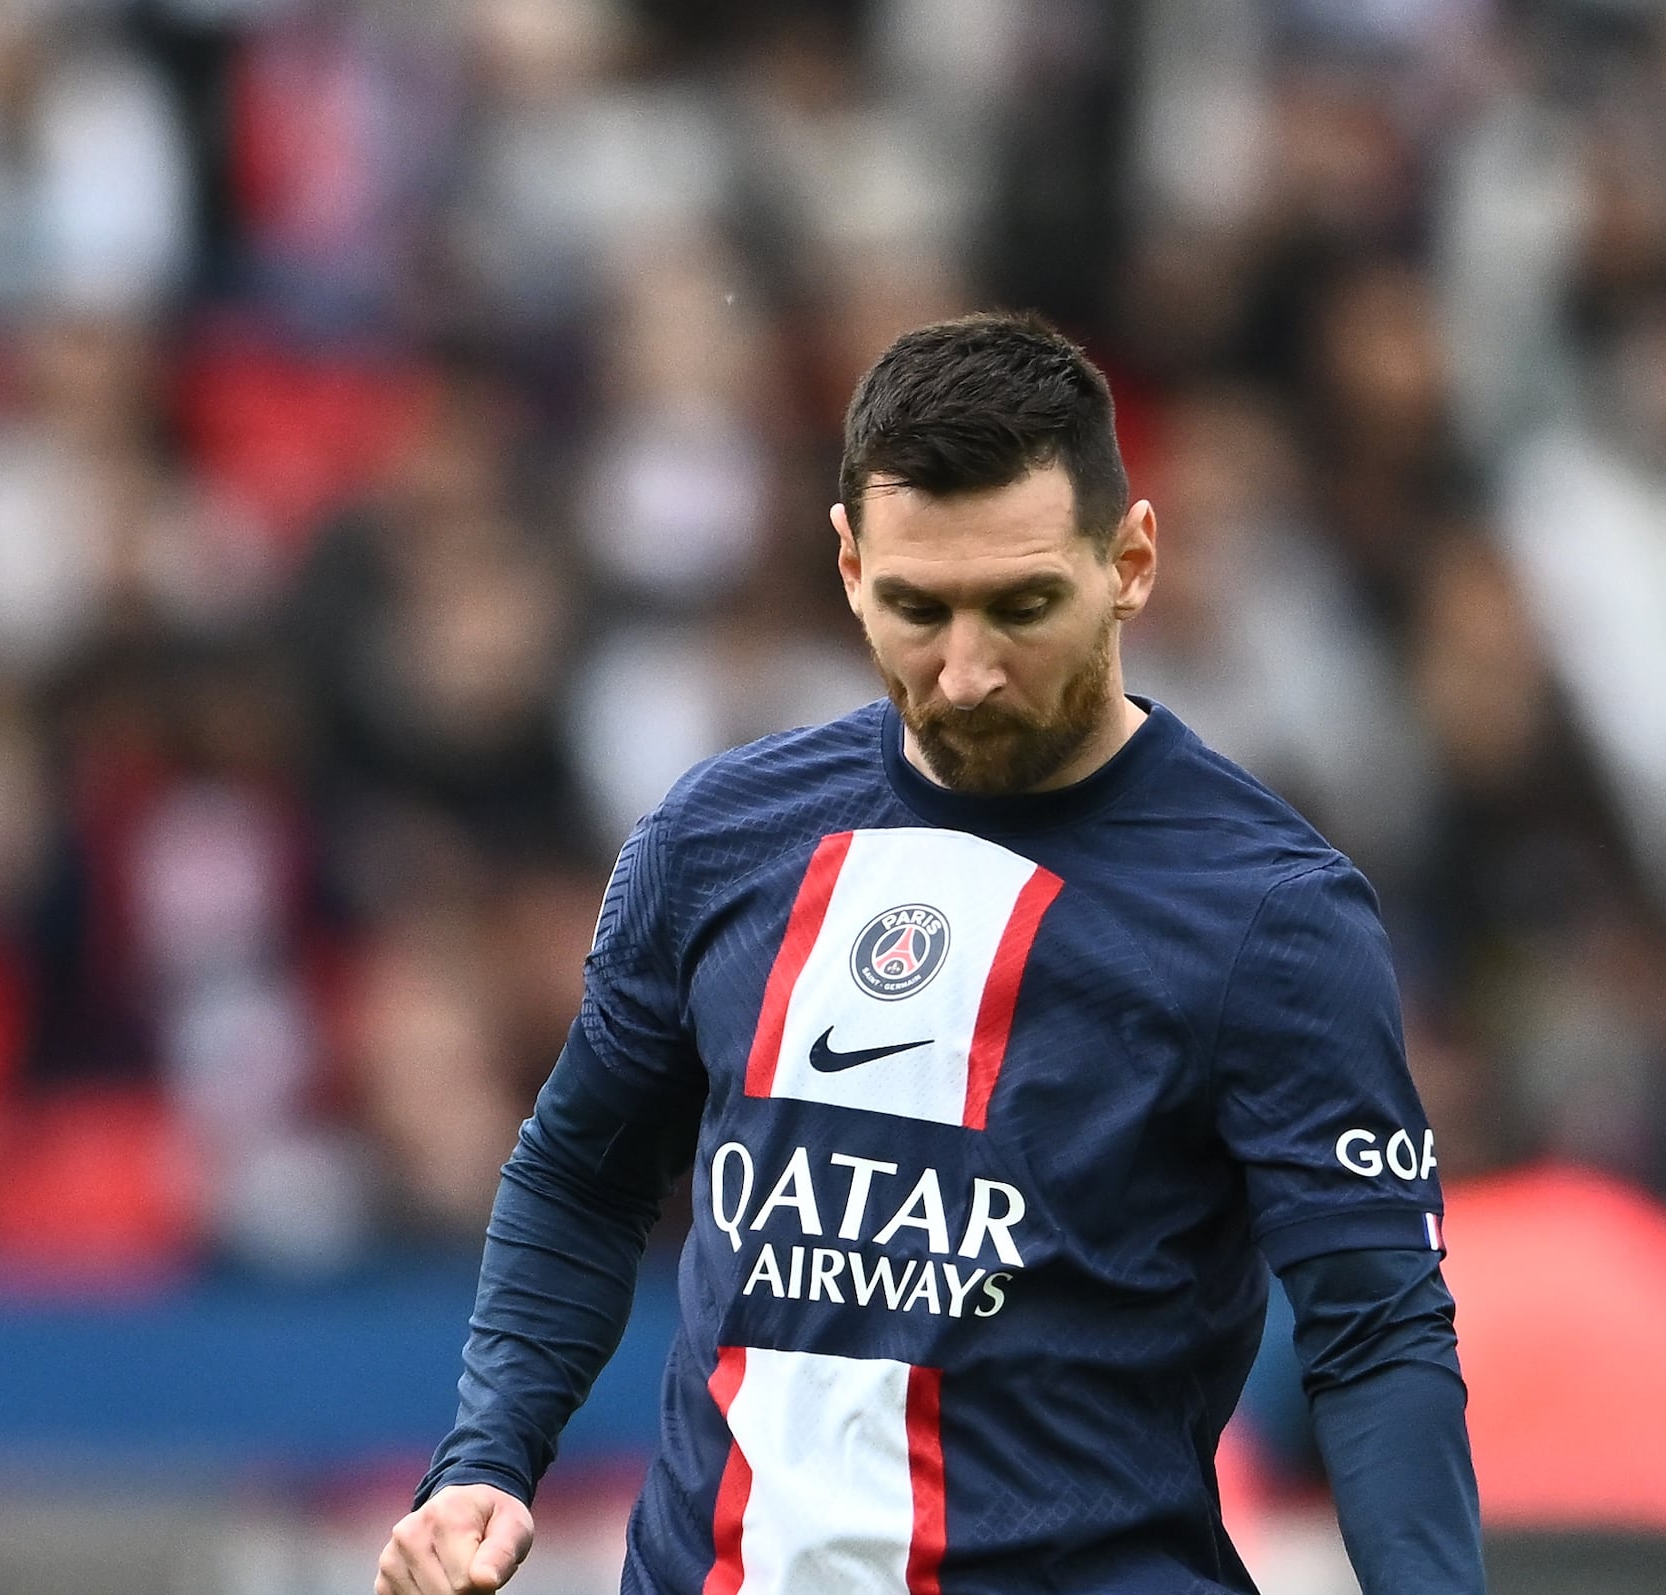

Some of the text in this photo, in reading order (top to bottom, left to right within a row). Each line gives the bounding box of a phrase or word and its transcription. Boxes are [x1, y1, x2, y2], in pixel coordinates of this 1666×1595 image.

[881, 909, 942, 936] PARIS
[711, 1141, 1026, 1267] QATAR
[743, 1242, 1013, 1318] AIRWAYS
